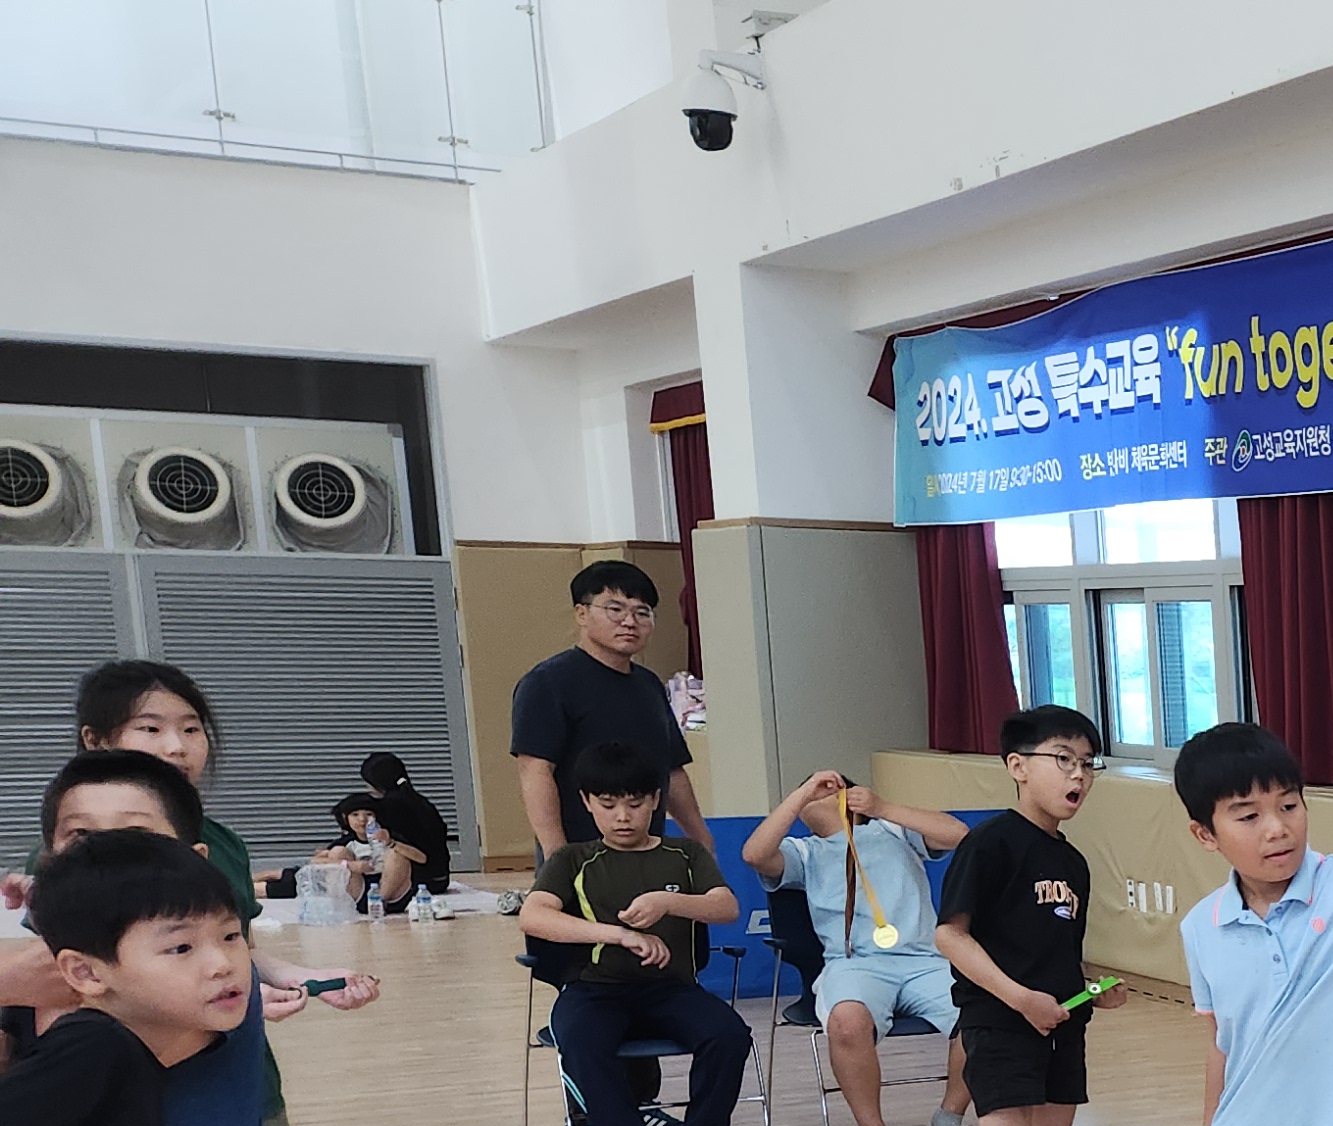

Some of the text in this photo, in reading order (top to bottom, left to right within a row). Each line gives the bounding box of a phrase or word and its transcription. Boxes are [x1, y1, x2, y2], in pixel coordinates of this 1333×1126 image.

[916, 373, 987, 442] 2024.
[986, 361, 1049, 431] 고성
[1044, 333, 1161, 418] 특수교육
[1079, 453, 1107, 480] 장소
[1204, 437, 1228, 466] 주관
[1251, 424, 1331, 462] 고성교육지원청
